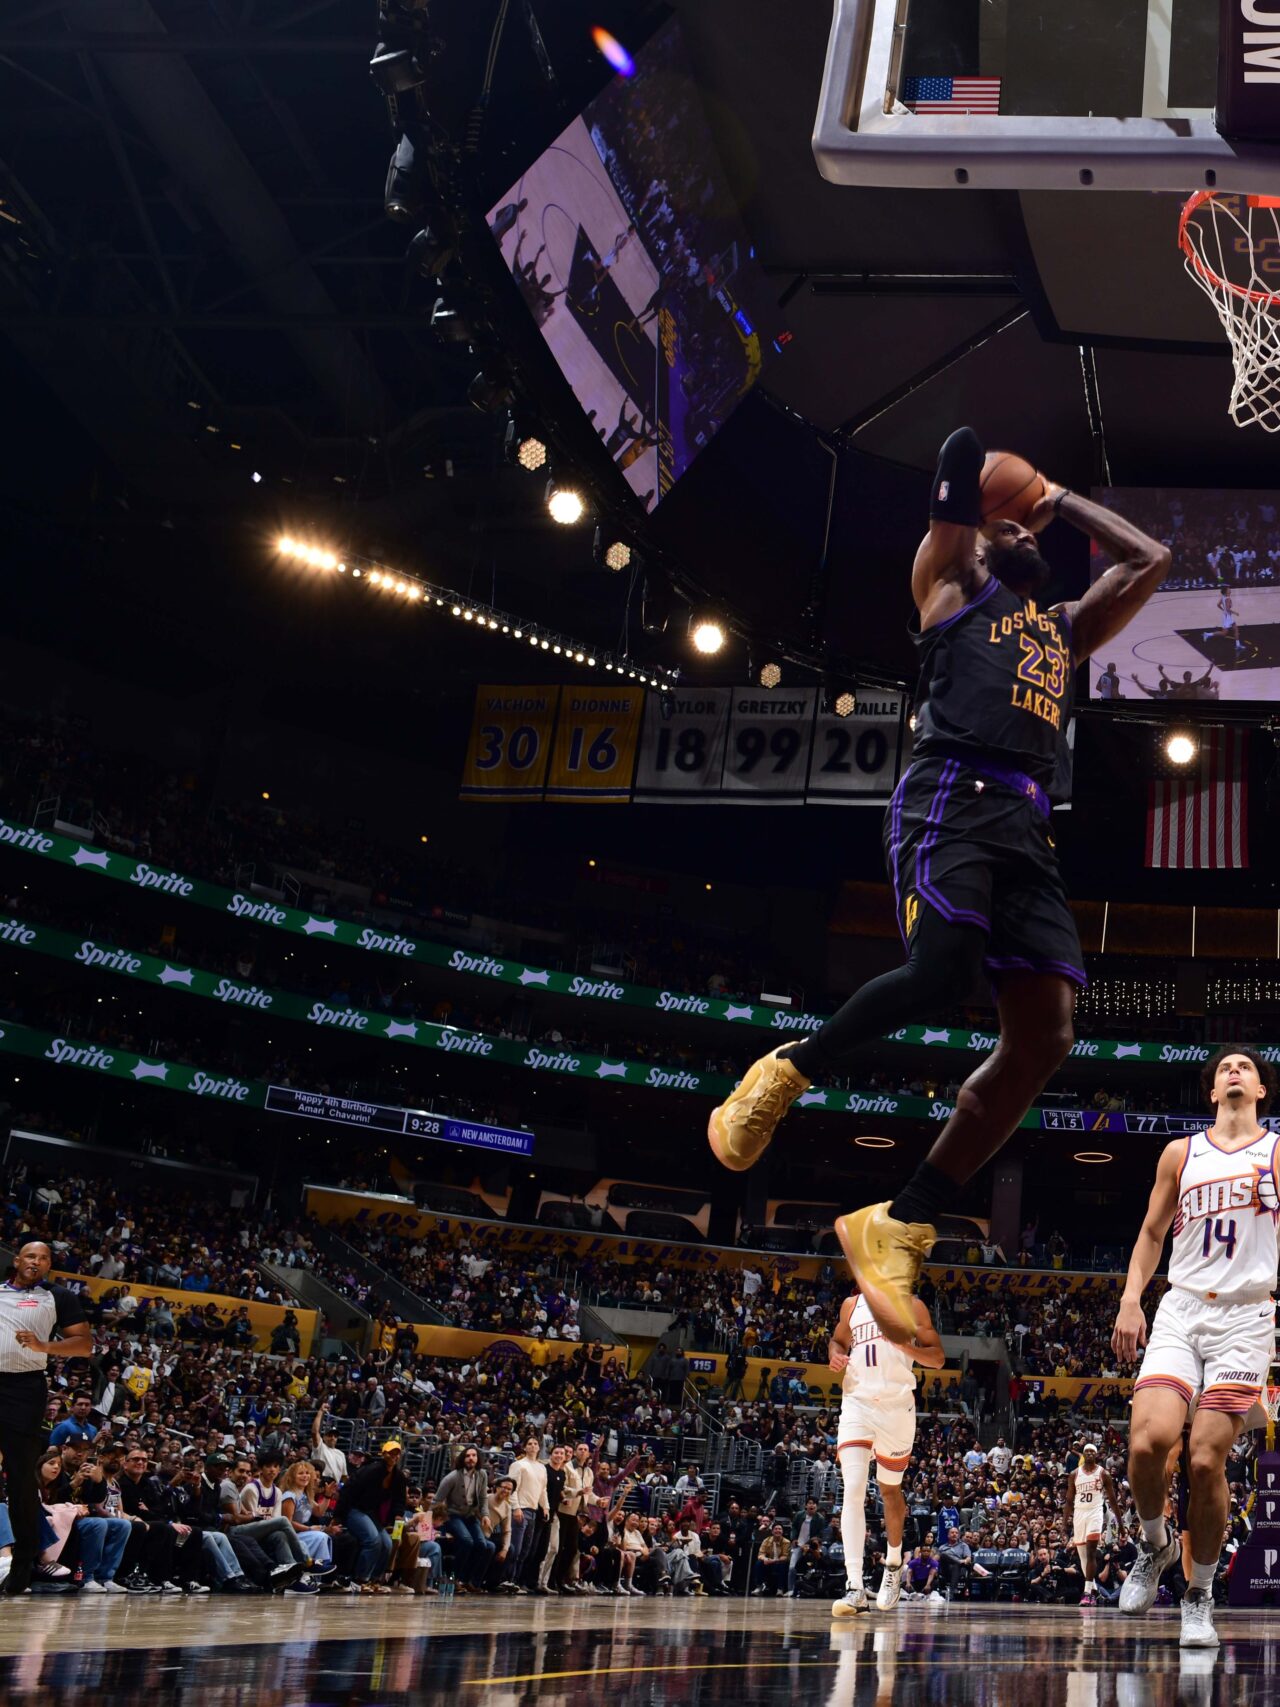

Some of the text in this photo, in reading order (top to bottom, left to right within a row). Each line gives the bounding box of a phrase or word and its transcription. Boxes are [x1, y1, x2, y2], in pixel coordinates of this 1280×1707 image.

[989, 612, 1024, 643] LOS
[1017, 632, 1065, 698] 23
[488, 698, 547, 712] VACHON
[571, 699, 632, 712] DIONNE
[738, 701, 807, 714] GRETZKY
[820, 701, 898, 715] RTAILLE
[475, 725, 540, 771] 30
[566, 727, 619, 772] 16
[656, 728, 706, 772] 18
[736, 728, 800, 773] 99
[821, 728, 888, 774] 20
[130, 864, 193, 896] Sprite
[227, 895, 286, 924] Sprite
[0, 919, 36, 944] rite
[357, 929, 415, 955] Sprite
[75, 942, 141, 972] Sprite
[448, 951, 503, 976] Sprite
[213, 980, 272, 1008] Sprite
[568, 977, 624, 999] Sprite
[656, 992, 709, 1013] Sprite
[307, 1003, 368, 1029] Sprite
[771, 1011, 823, 1031] Sprite
[437, 1030, 492, 1055] Sprite
[967, 1033, 1000, 1051] Spr
[1068, 1039, 1099, 1056] rite
[45, 1039, 113, 1069] Sprite
[524, 1049, 580, 1071] Sprite
[1159, 1045, 1209, 1062] Sprite
[188, 1072, 249, 1100] Sprite
[645, 1068, 699, 1089] Sprite
[294, 1091, 377, 1115] Happy 4th Birthday
[298, 1103, 371, 1124] Amari Chavarin!
[846, 1094, 897, 1113] Sprite
[411, 1118, 440, 1134] 9:28
[1051, 1118, 1058, 1128] 4
[1069, 1119, 1077, 1128] 5
[1137, 1116, 1158, 1132] 77
[1183, 1121, 1215, 1131] Laker
[461, 1128, 477, 1140] NEW
[478, 1131, 523, 1148] AMSTERDAM
[1245, 1150, 1269, 1158] PayPal
[1181, 1176, 1254, 1227] SUNS
[1203, 1217, 1237, 1260] 14
[851, 1323, 882, 1348] SUN
[693, 1360, 713, 1371] 115
[865, 1344, 877, 1367] 11
[1215, 1371, 1260, 1383] PHOENIX
[1080, 1493, 1093, 1503] 20
